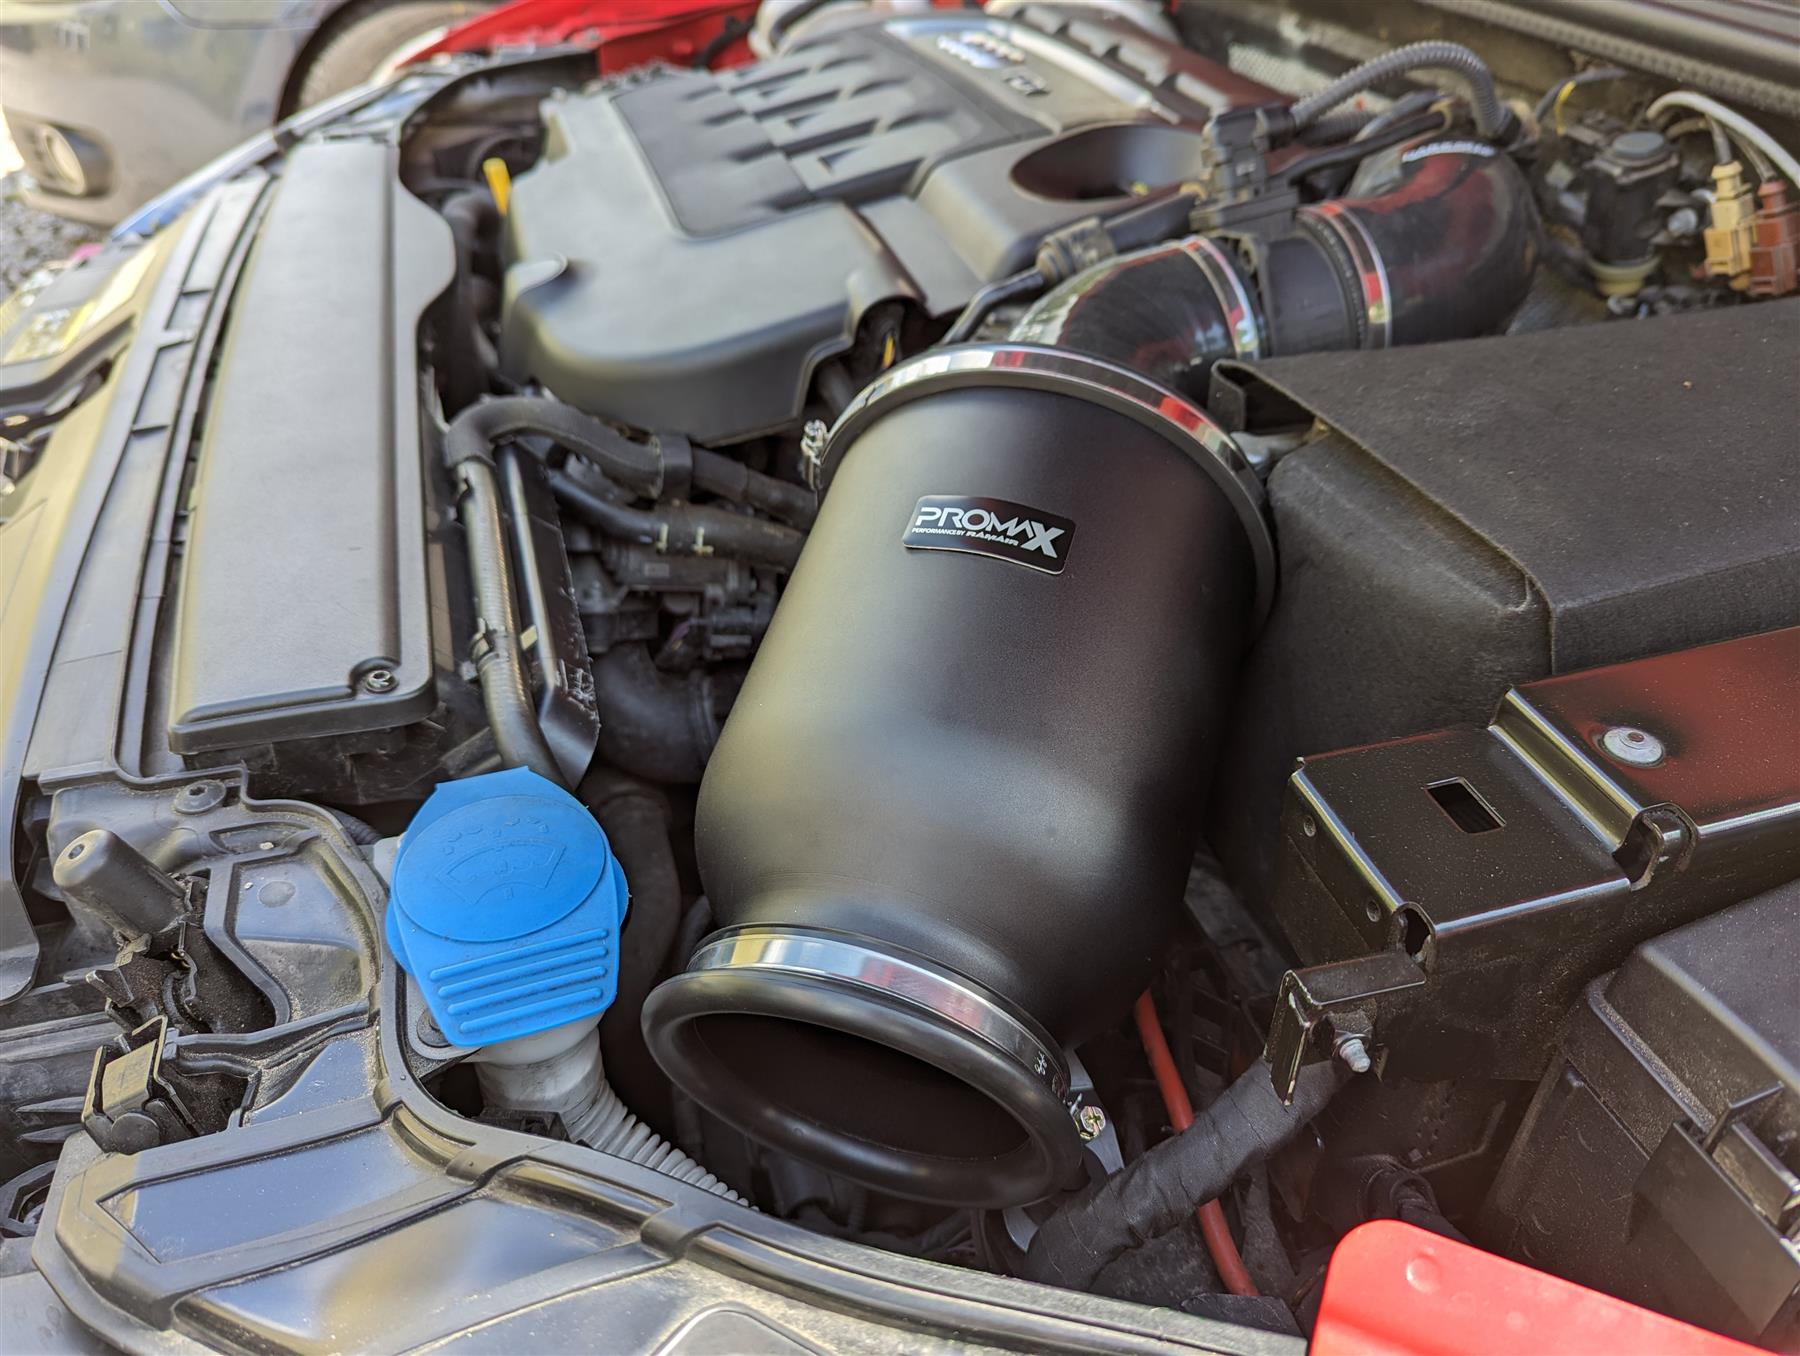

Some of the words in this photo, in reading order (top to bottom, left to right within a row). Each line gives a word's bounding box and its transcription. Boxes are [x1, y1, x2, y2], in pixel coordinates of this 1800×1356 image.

[911, 527, 957, 536] PERFORMANCE
[966, 530, 1019, 546] RAMAIR
[915, 507, 1065, 558] PROMAX
